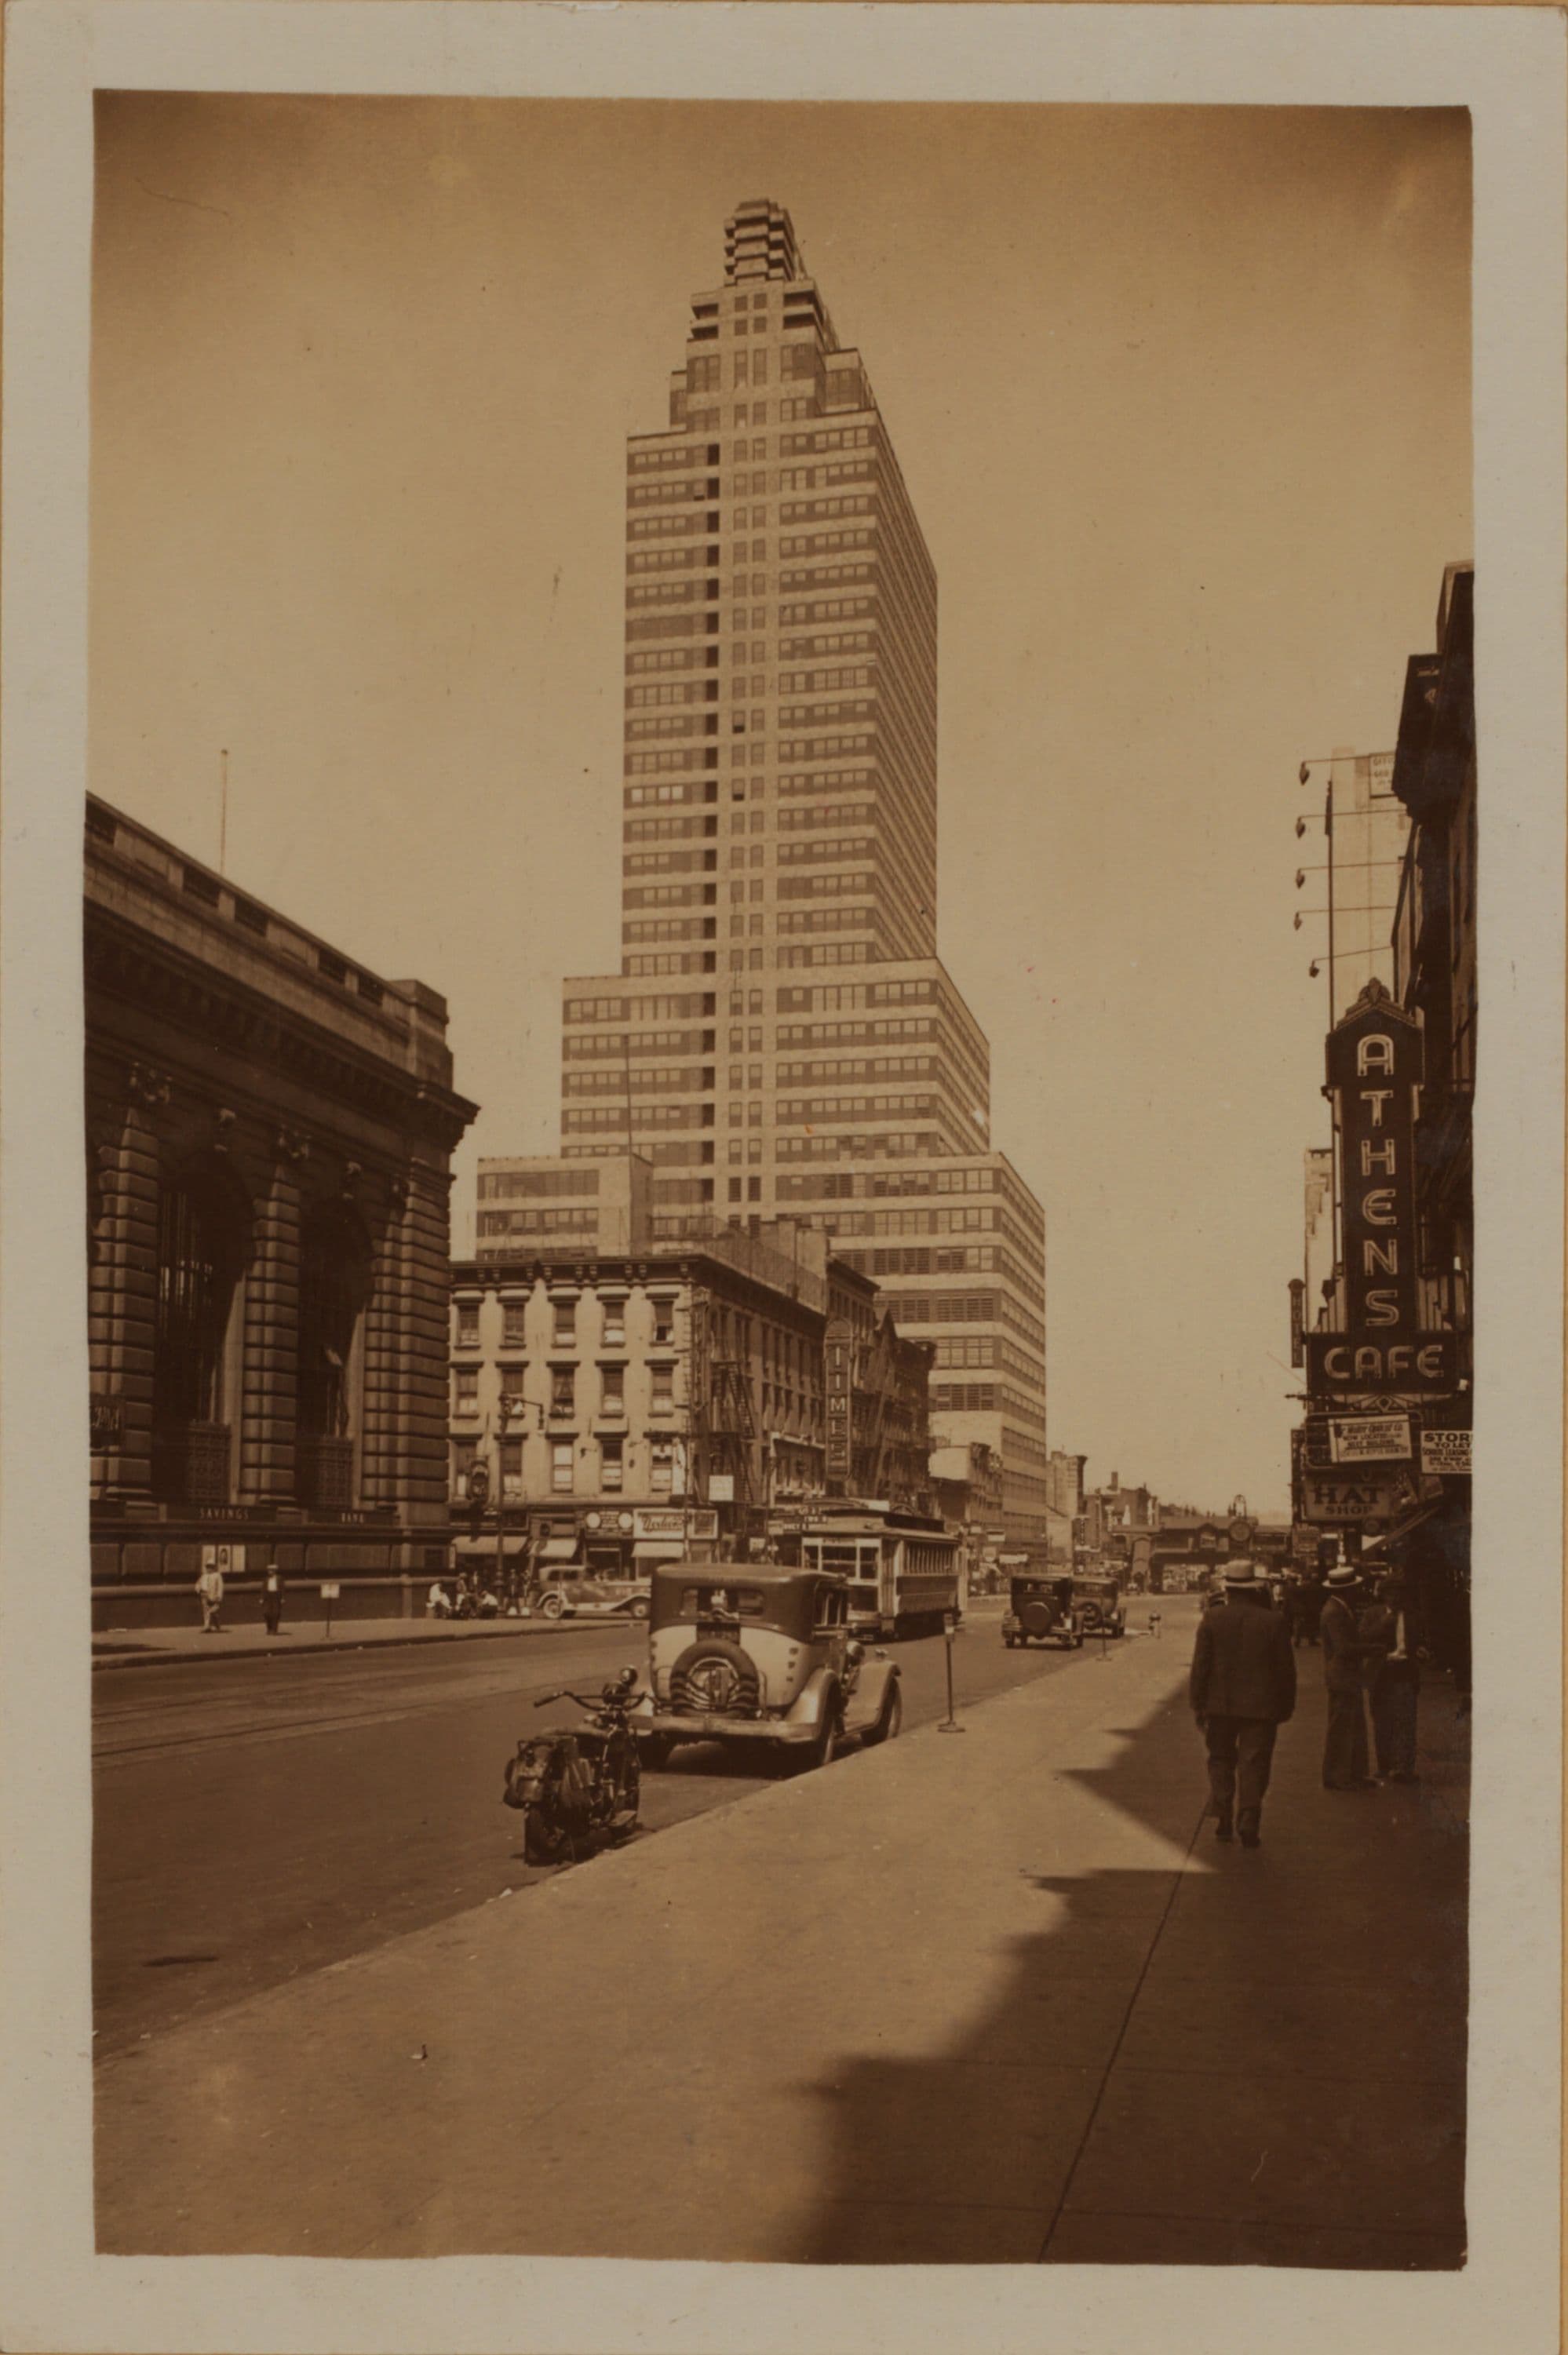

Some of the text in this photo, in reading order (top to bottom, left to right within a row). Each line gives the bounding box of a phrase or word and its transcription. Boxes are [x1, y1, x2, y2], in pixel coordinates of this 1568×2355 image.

[1357, 1034, 1398, 1326] ATHENS
[1324, 1344, 1444, 1379] CAFE
[1424, 1433, 1471, 1442] STOR
[1313, 1486, 1384, 1504] HAT
[199, 1507, 250, 1520] SAVINGS
[1326, 1506, 1373, 1515] SHOP
